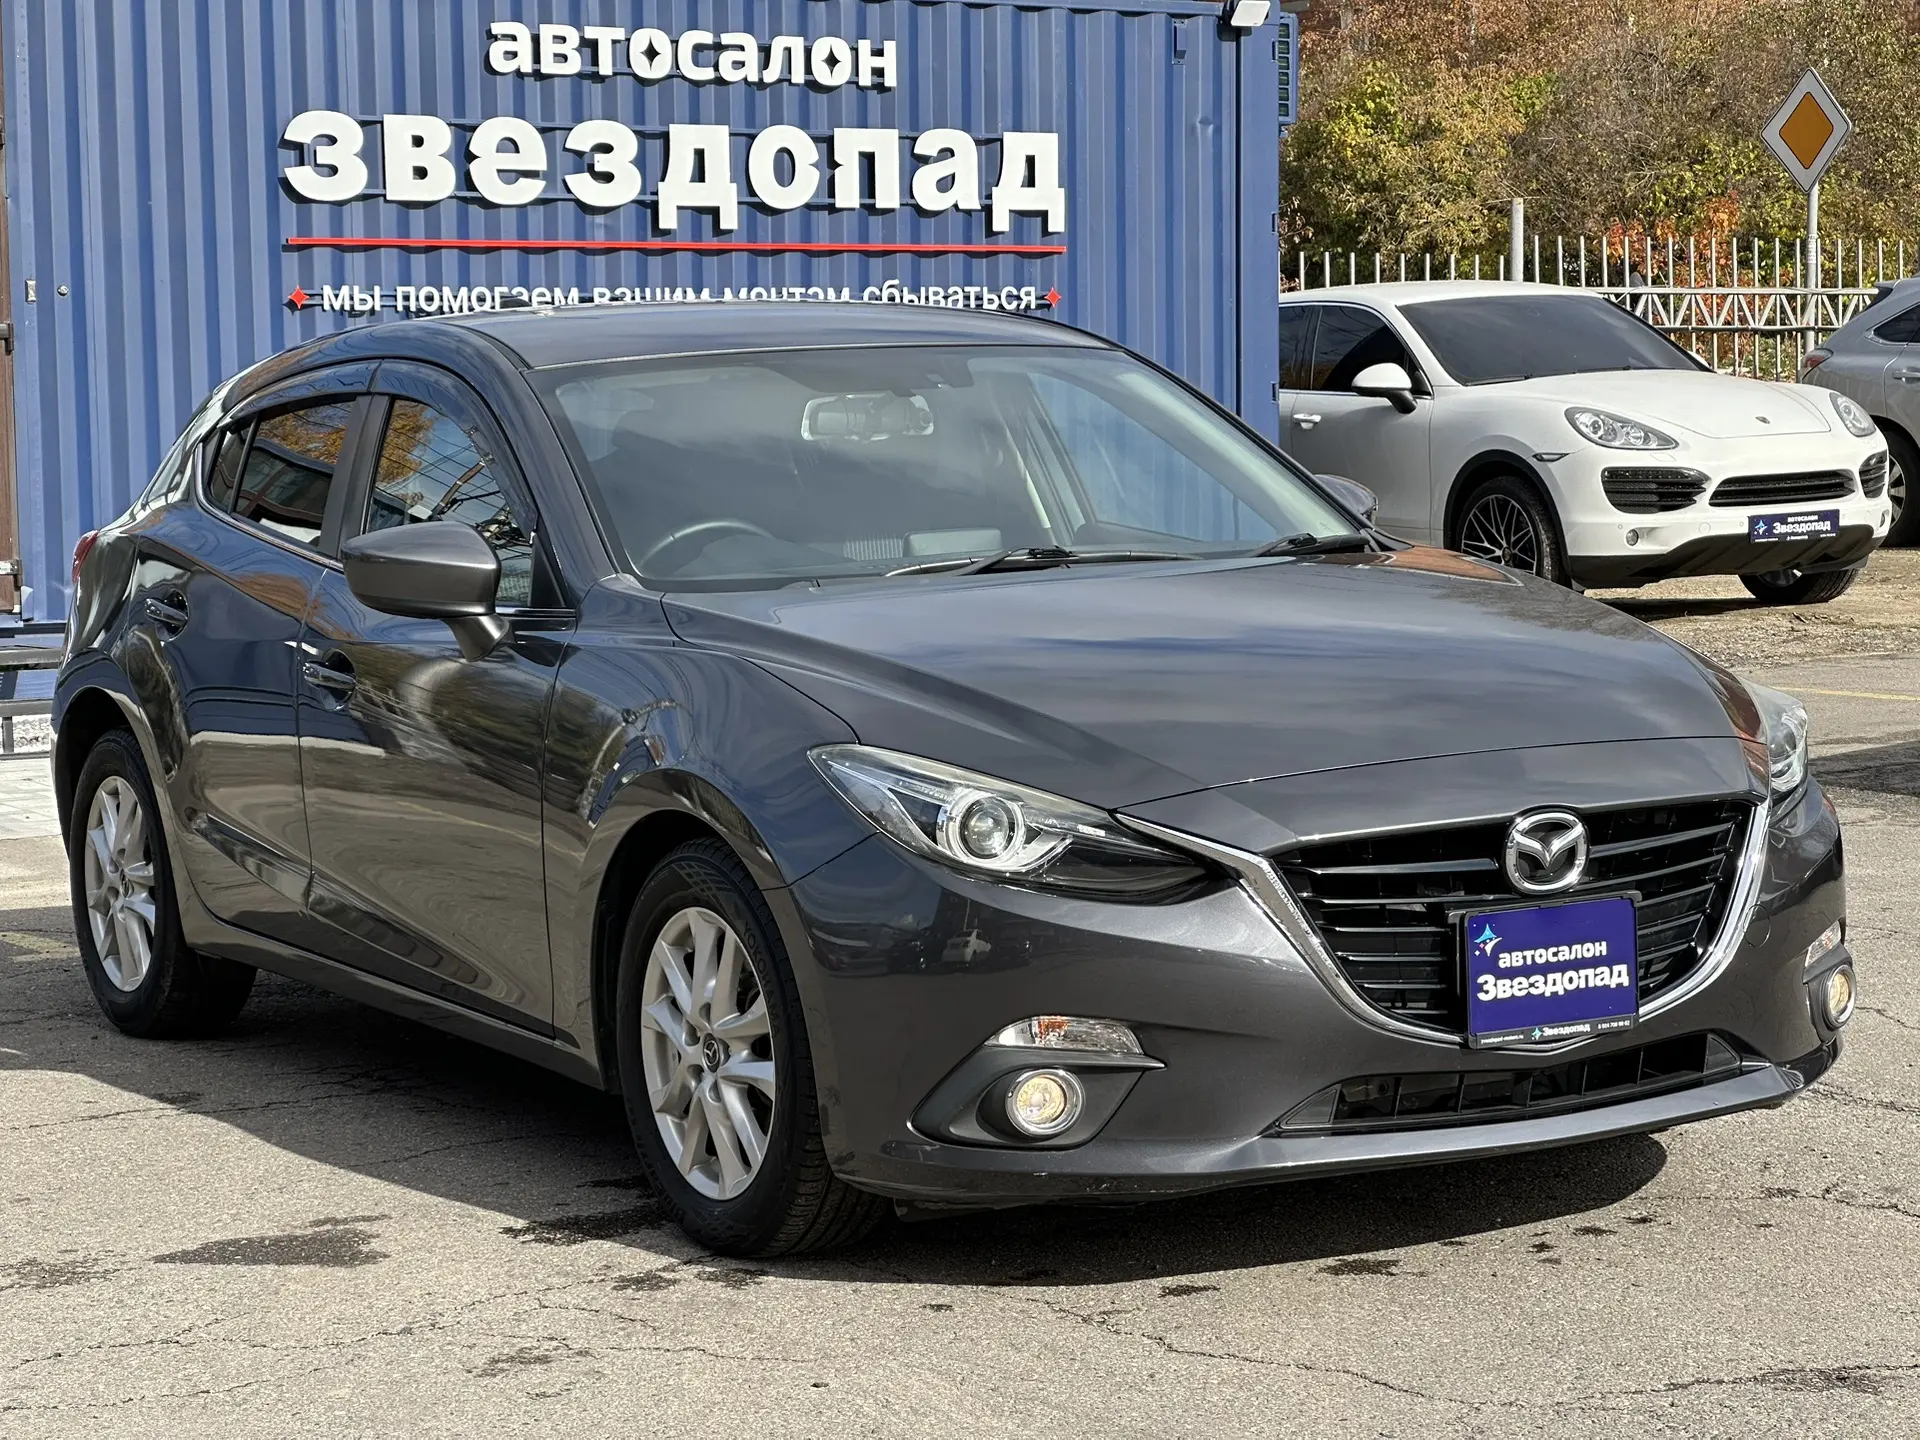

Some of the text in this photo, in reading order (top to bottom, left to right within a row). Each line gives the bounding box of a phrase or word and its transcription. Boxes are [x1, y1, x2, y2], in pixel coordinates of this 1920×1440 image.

[488, 21, 897, 87] автосалон
[322, 285, 381, 311] мы
[864, 279, 1036, 310] сбываться
[1772, 520, 1831, 534] Звездопад
[1498, 941, 1607, 968] автосалон
[1476, 964, 1629, 1001] Звездопад
[1542, 1024, 1591, 1036] Звездопад
